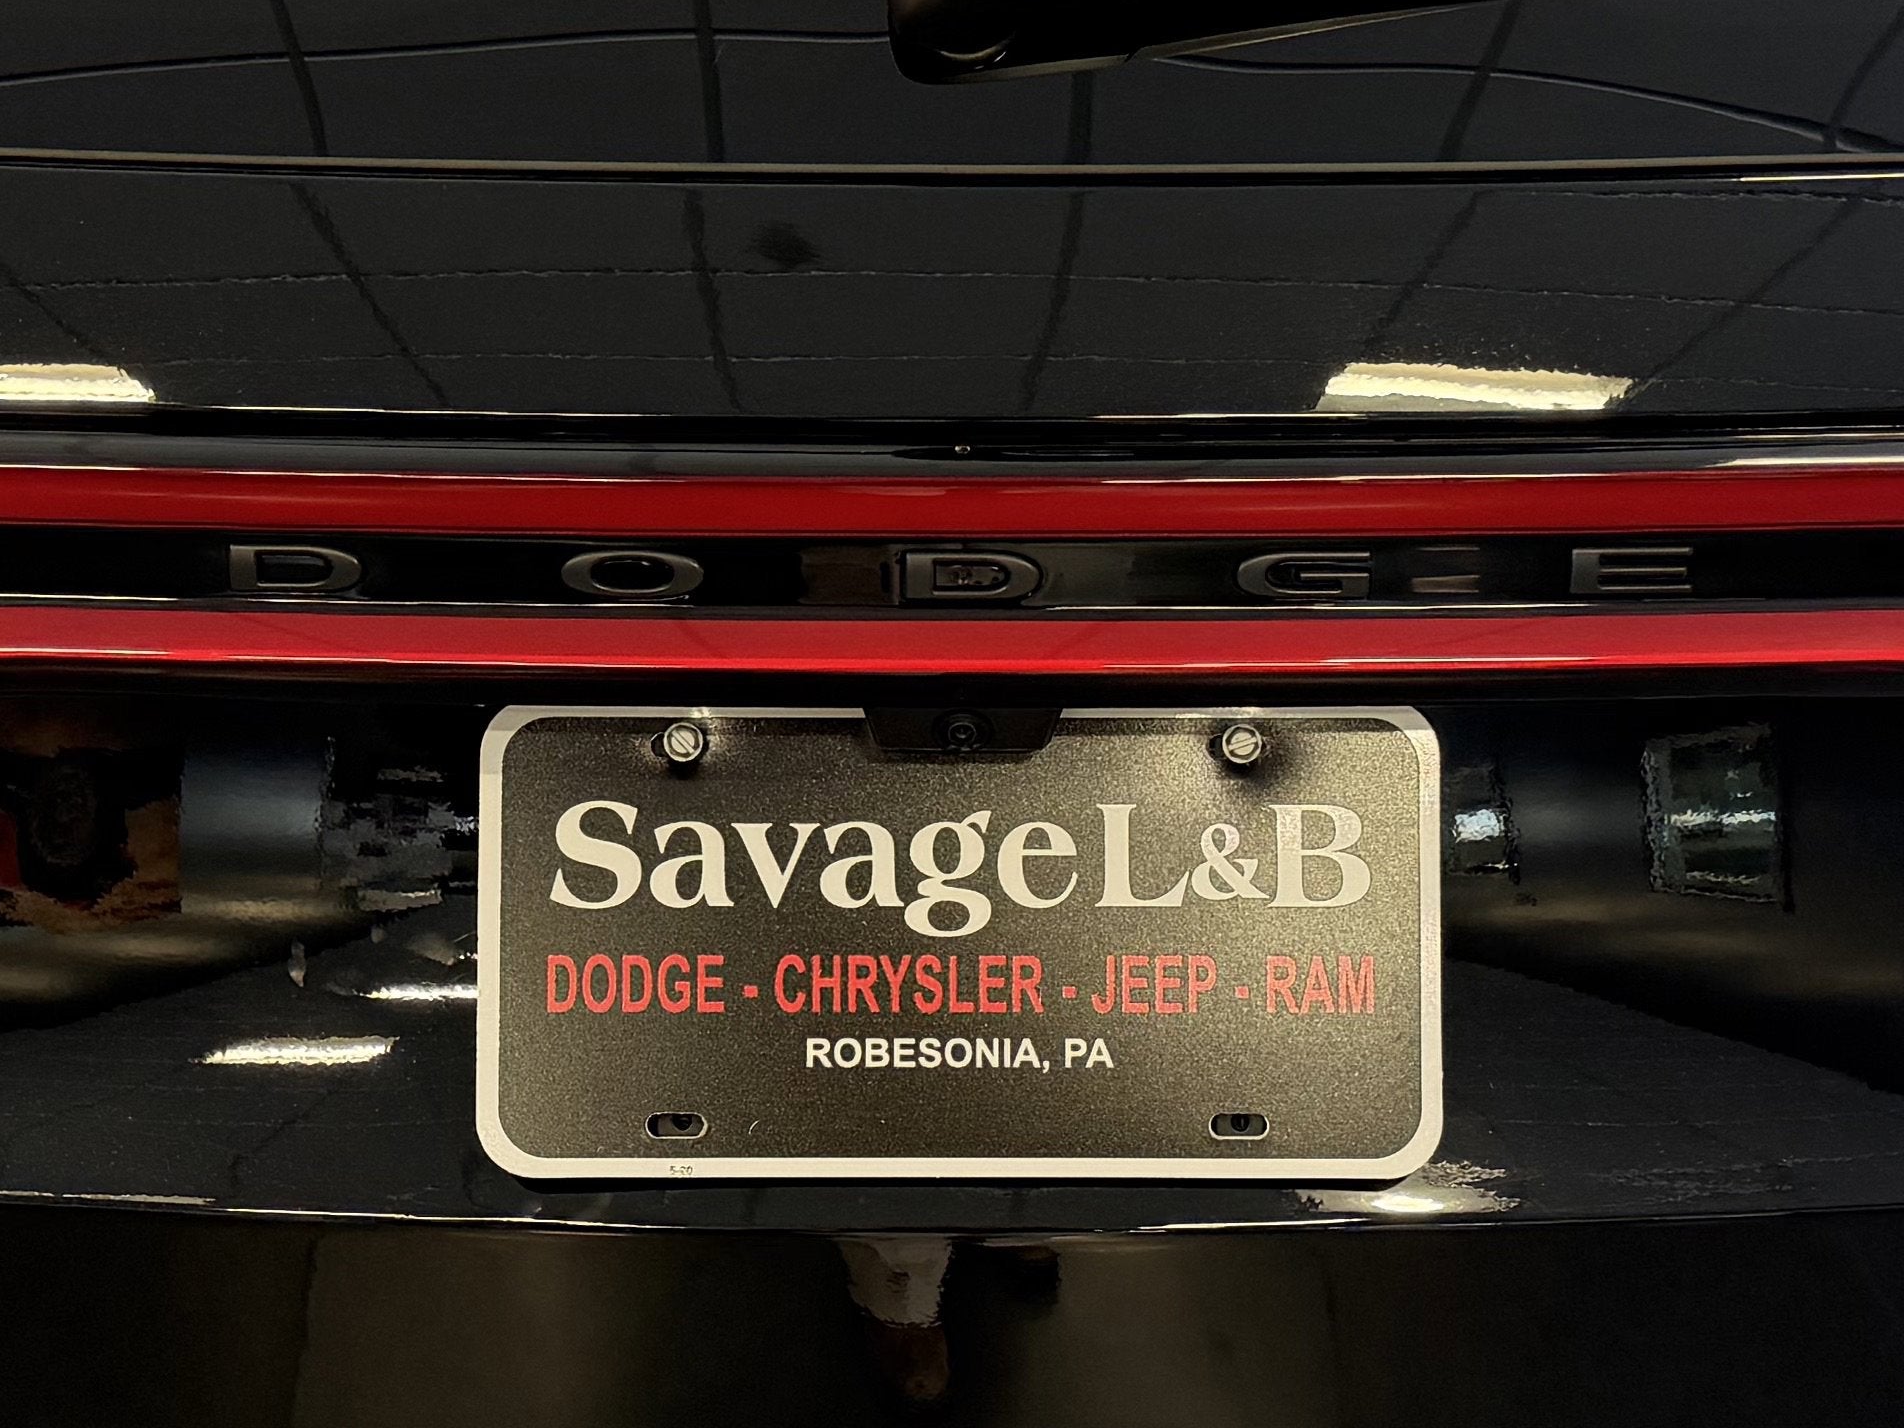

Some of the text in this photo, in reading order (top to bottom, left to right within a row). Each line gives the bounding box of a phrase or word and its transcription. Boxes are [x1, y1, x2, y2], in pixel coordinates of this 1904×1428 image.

[227, 543, 1696, 603] DODGE
[549, 800, 1373, 938] Savage L&B
[546, 954, 726, 1014] DODGE
[774, 954, 1044, 1015] CHRYSLER
[1091, 955, 1216, 1014] JEEP
[1267, 955, 1375, 1014] RAM
[805, 1036, 1116, 1074] ROBESONIA, PA
